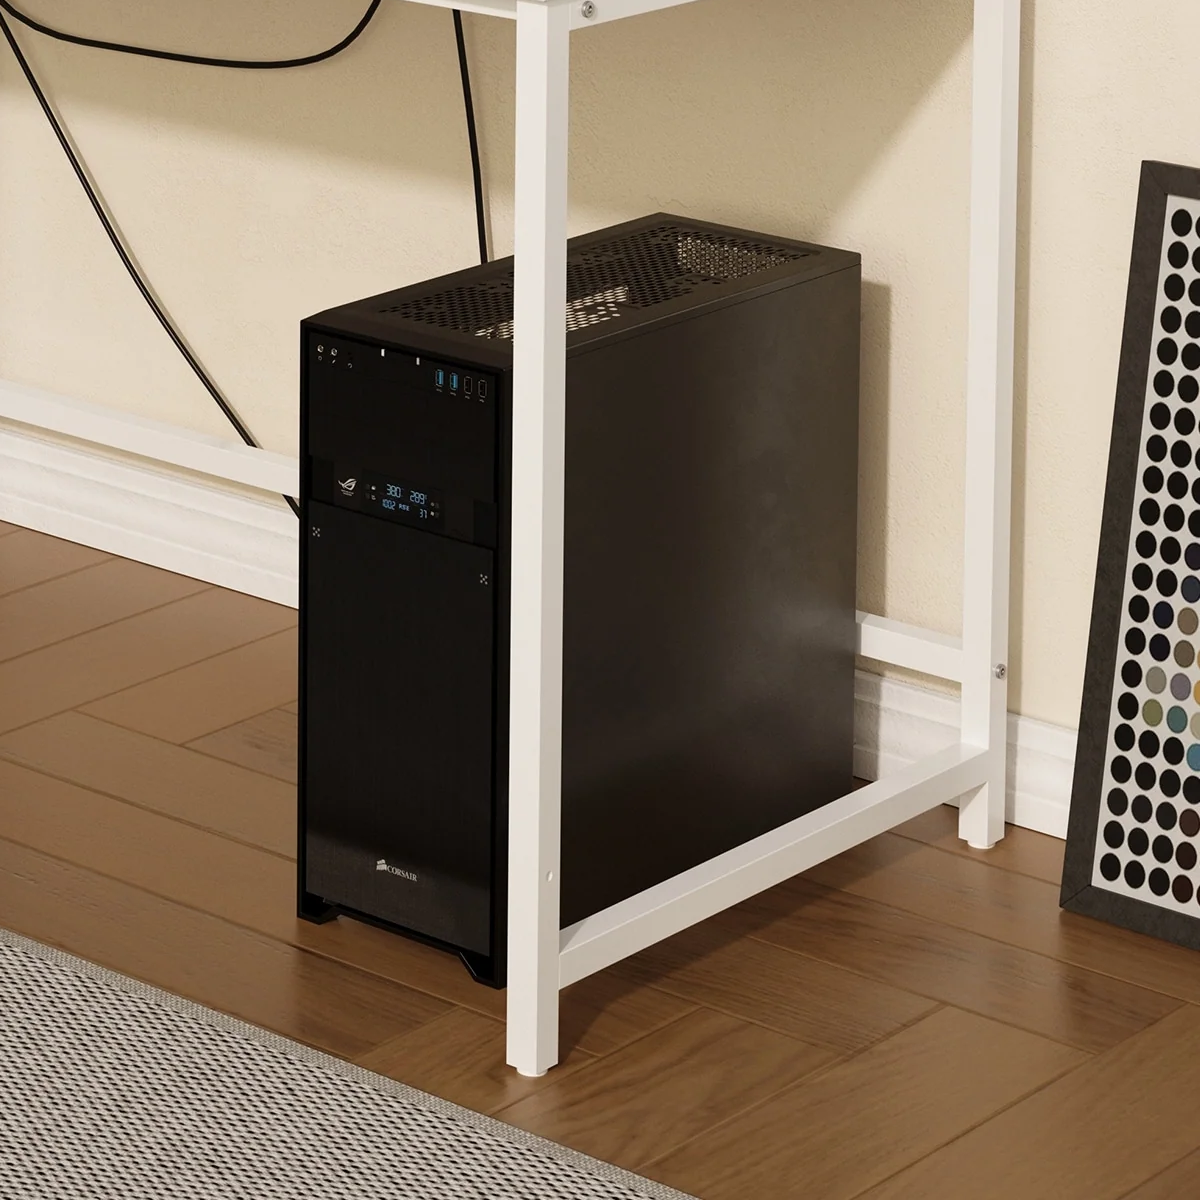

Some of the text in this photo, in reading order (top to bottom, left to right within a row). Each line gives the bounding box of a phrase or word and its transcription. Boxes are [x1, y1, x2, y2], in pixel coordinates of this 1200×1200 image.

[386, 484, 425, 505] 380 289
[387, 865, 418, 882] CORSAIR
